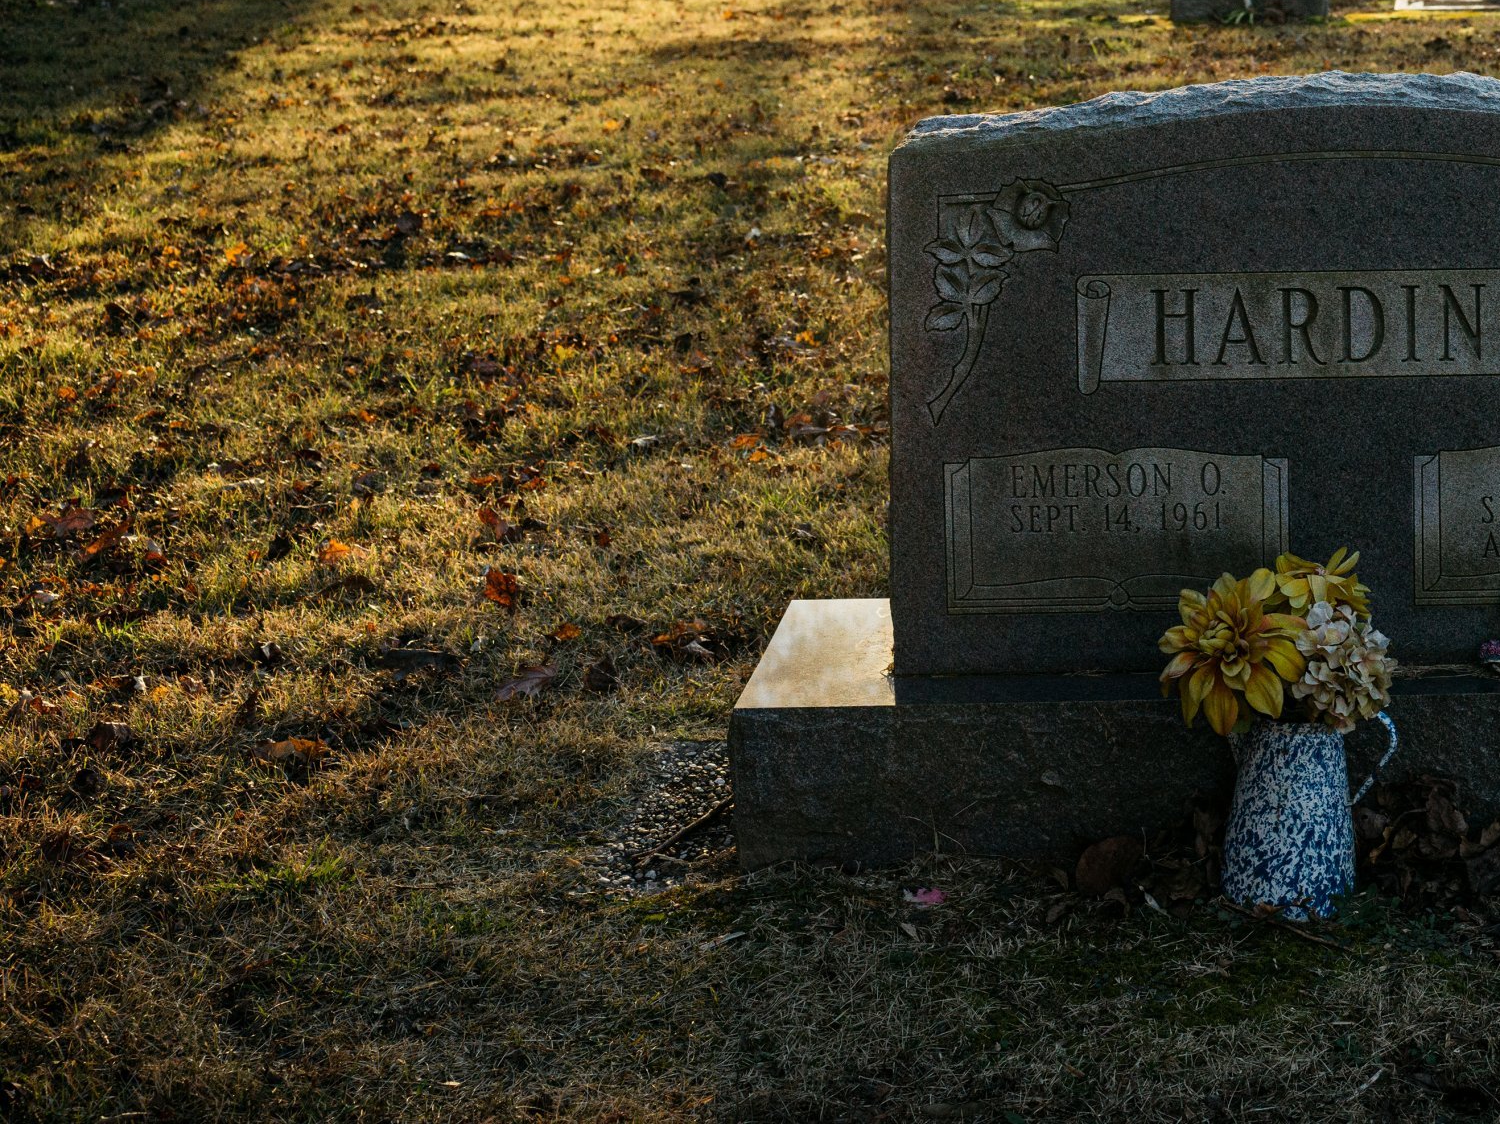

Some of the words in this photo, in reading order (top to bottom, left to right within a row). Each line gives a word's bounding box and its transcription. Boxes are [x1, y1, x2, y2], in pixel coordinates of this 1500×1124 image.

[1010, 462, 1173, 499] EMERSON
[1200, 461, 1227, 496] O.
[1010, 503, 1087, 534] SEPT.
[1103, 503, 1141, 534] 14,
[1159, 501, 1223, 532] 1961
